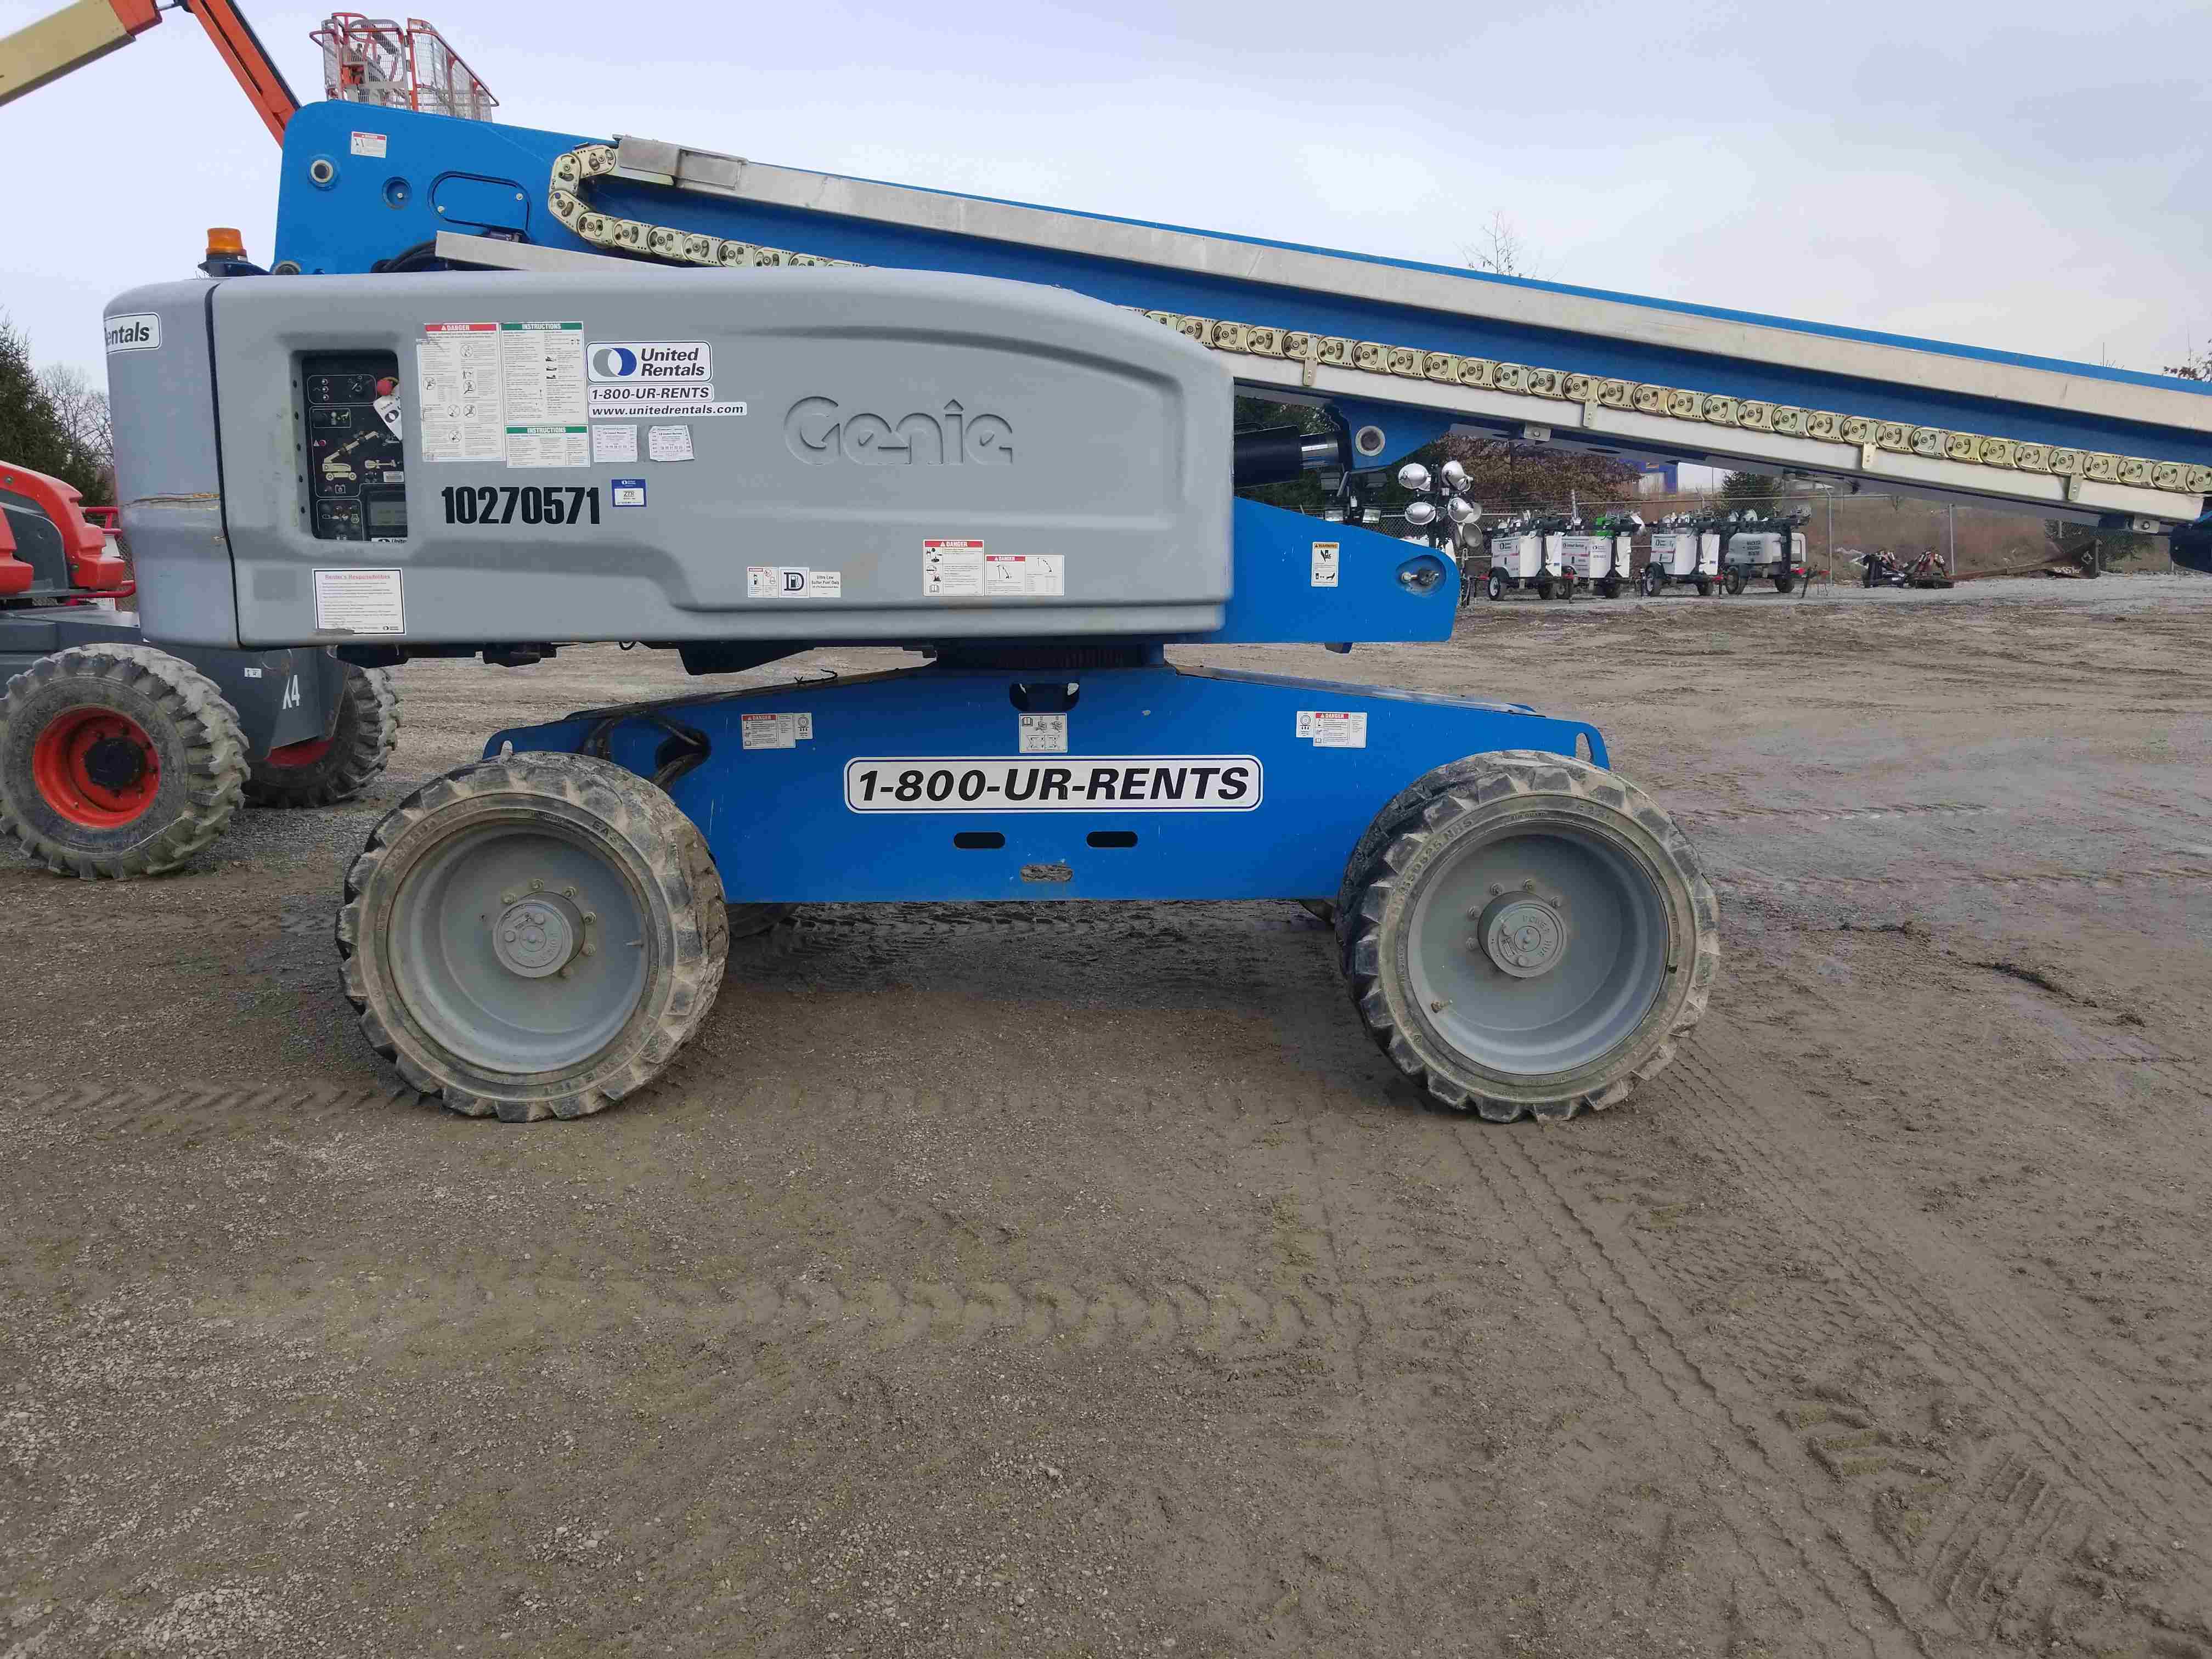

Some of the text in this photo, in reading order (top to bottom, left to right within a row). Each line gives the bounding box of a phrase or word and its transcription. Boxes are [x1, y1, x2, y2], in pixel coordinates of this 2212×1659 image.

[104, 321, 150, 347] entals
[640, 347, 699, 362] United
[641, 363, 705, 377] Rentals
[592, 387, 709, 400] 1-800-UR-RENTS
[592, 405, 744, 416] www.unitedrentals.com
[784, 396, 1013, 466] Genie
[441, 486, 601, 524] 10270571
[783, 572, 805, 591] D
[859, 767, 1249, 802] 1-800-UR-RENTS
